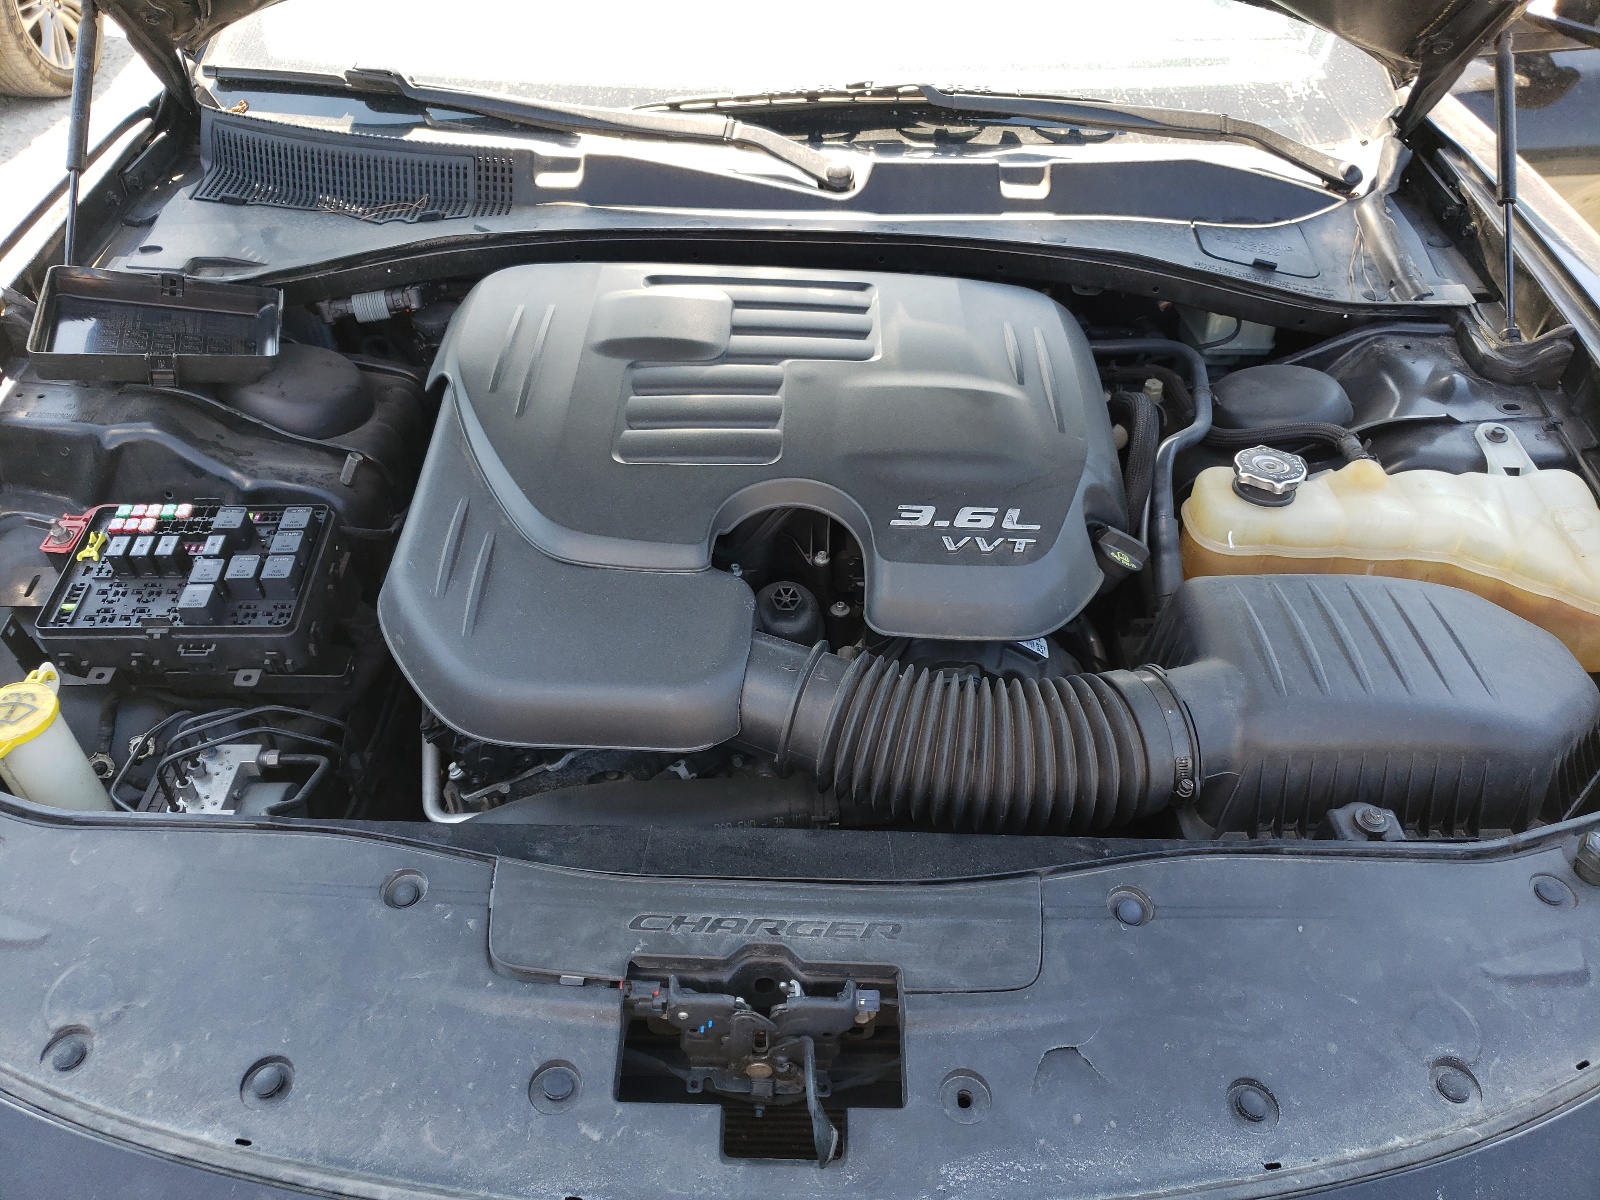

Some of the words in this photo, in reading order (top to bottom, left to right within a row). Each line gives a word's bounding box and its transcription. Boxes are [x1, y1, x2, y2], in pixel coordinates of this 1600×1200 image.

[889, 504, 1041, 531] 3.6L
[941, 535, 1037, 554] VVT
[628, 914, 904, 940] CHARGER
